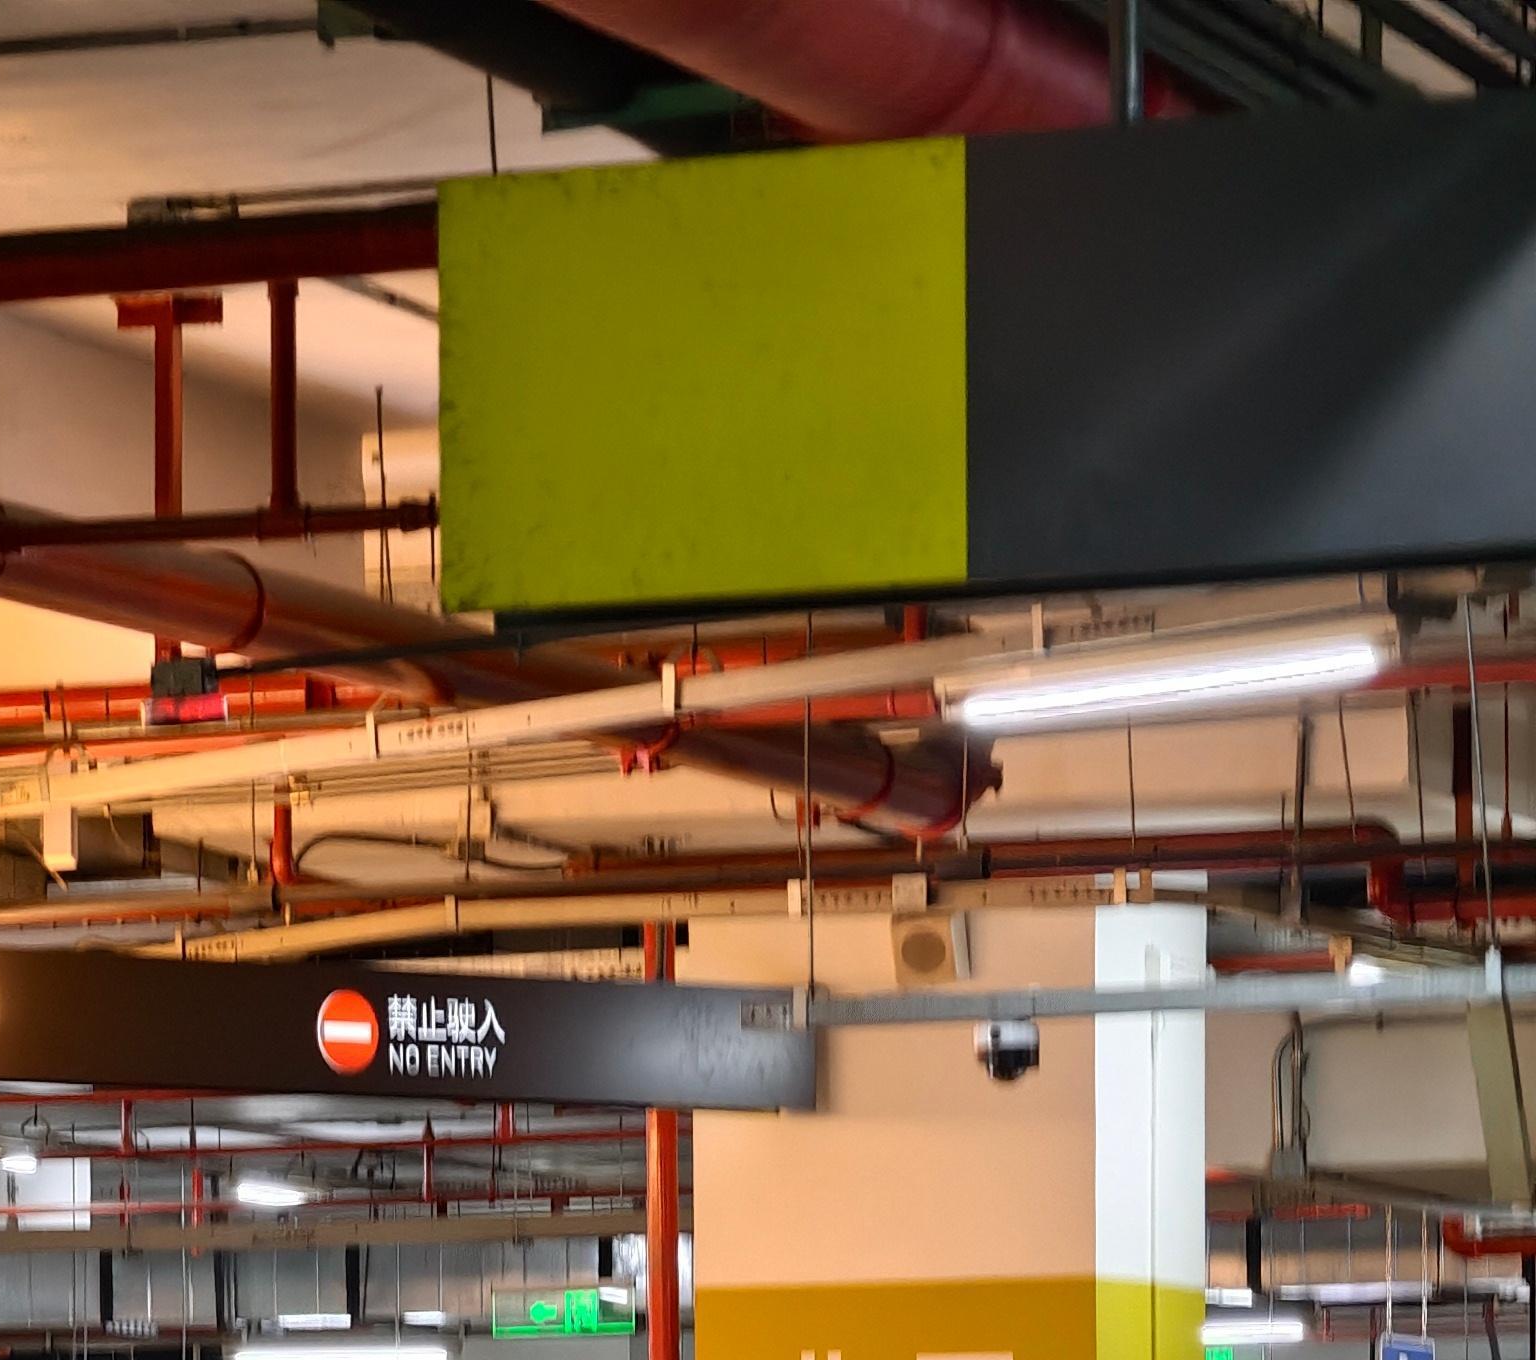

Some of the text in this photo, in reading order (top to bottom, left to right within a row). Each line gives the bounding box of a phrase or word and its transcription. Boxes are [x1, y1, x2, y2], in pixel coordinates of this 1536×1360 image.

[387, 993, 505, 1046] 禁止驶入
[389, 1042, 497, 1079] NO ENTRY
